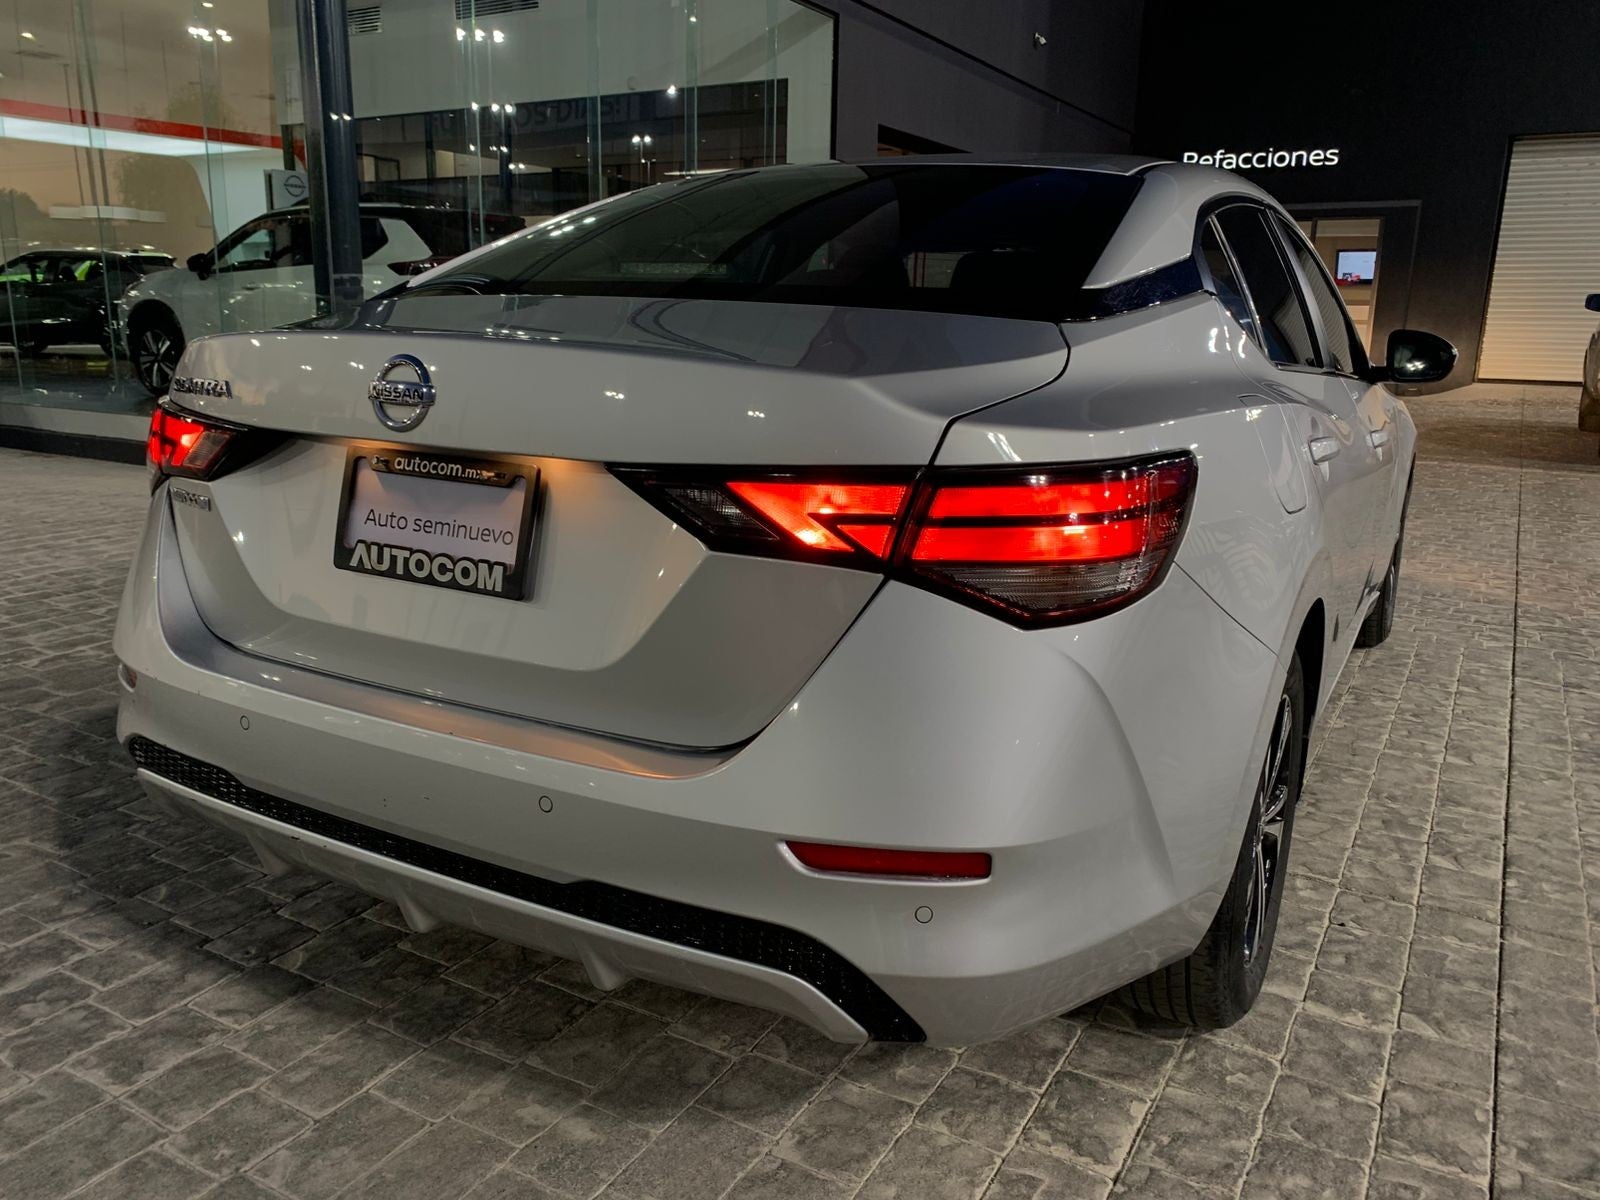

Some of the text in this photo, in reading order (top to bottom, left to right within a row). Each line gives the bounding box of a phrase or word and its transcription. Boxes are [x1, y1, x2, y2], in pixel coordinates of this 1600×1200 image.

[1183, 148, 1339, 169] Refacciones
[372, 385, 425, 401] NISSAN
[364, 509, 514, 546] Auto seminuevo
[349, 543, 505, 592] AUTOCOM
